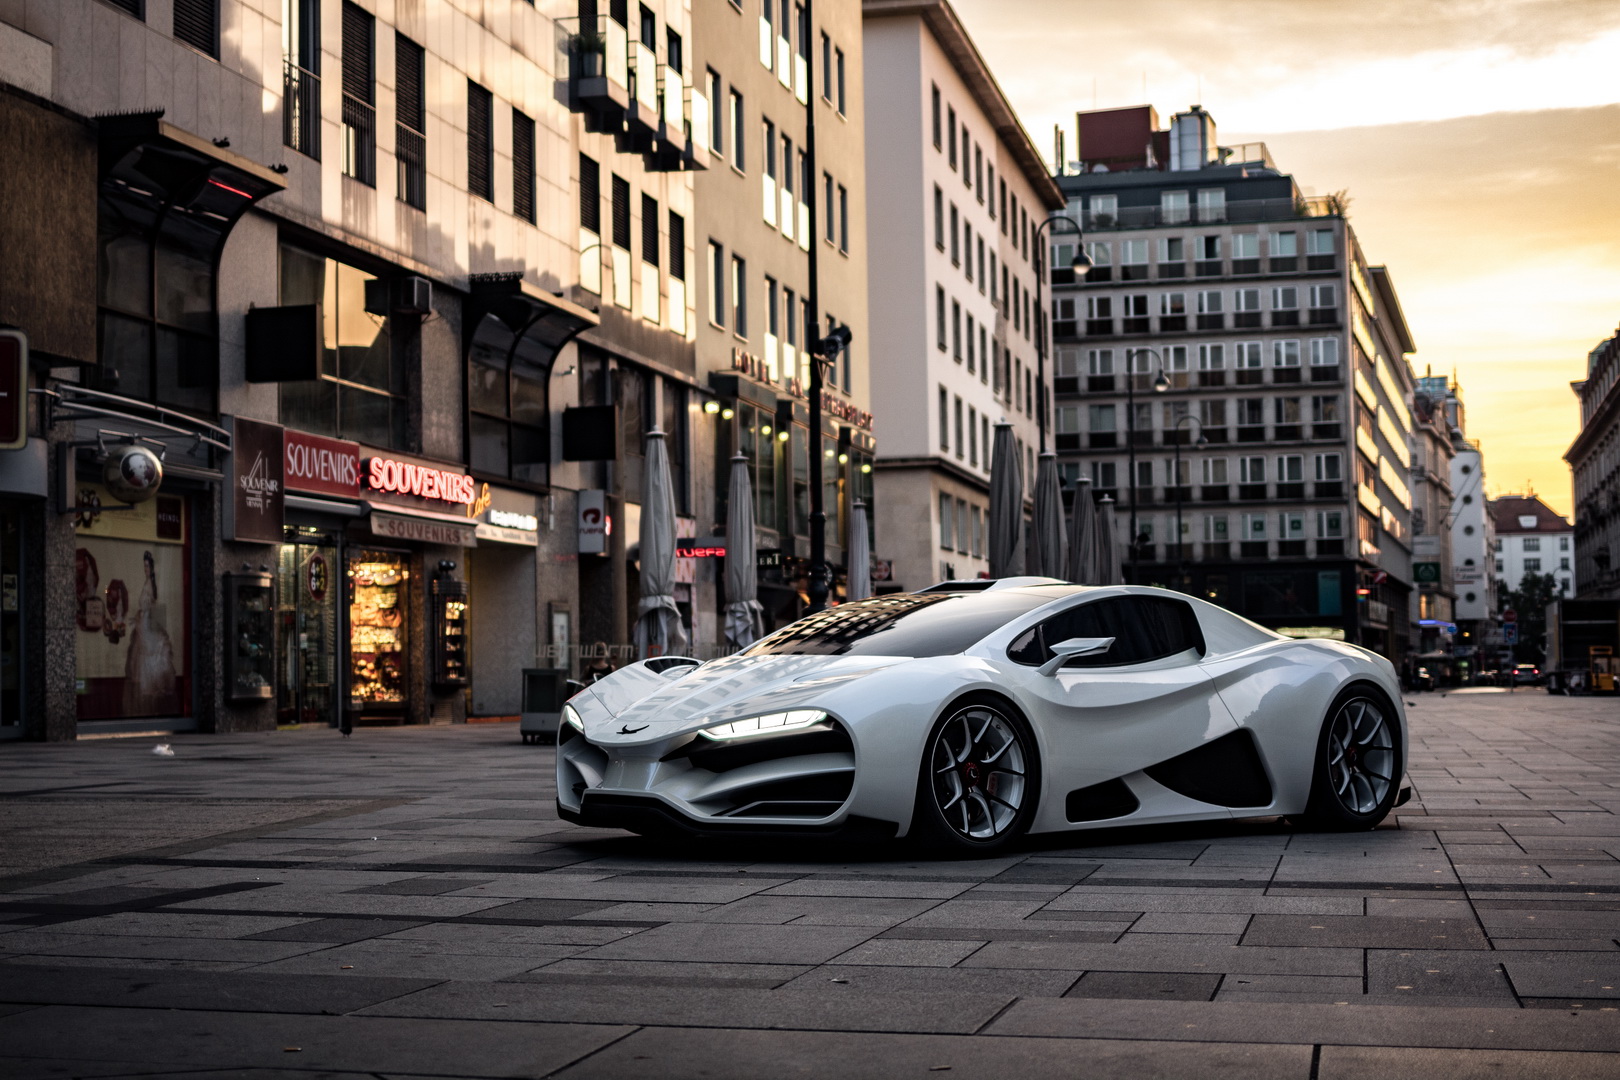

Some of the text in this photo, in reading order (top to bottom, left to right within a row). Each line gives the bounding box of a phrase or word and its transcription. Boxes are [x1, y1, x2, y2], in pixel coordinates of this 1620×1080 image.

[287, 443, 356, 486] SOUVENIRS
[240, 474, 279, 492] SOUVENIR
[368, 456, 476, 505] SOUVENIRS
[387, 520, 461, 544] SOUVENIRS
[676, 547, 726, 558] ruefa
[756, 552, 782, 566] ERT
